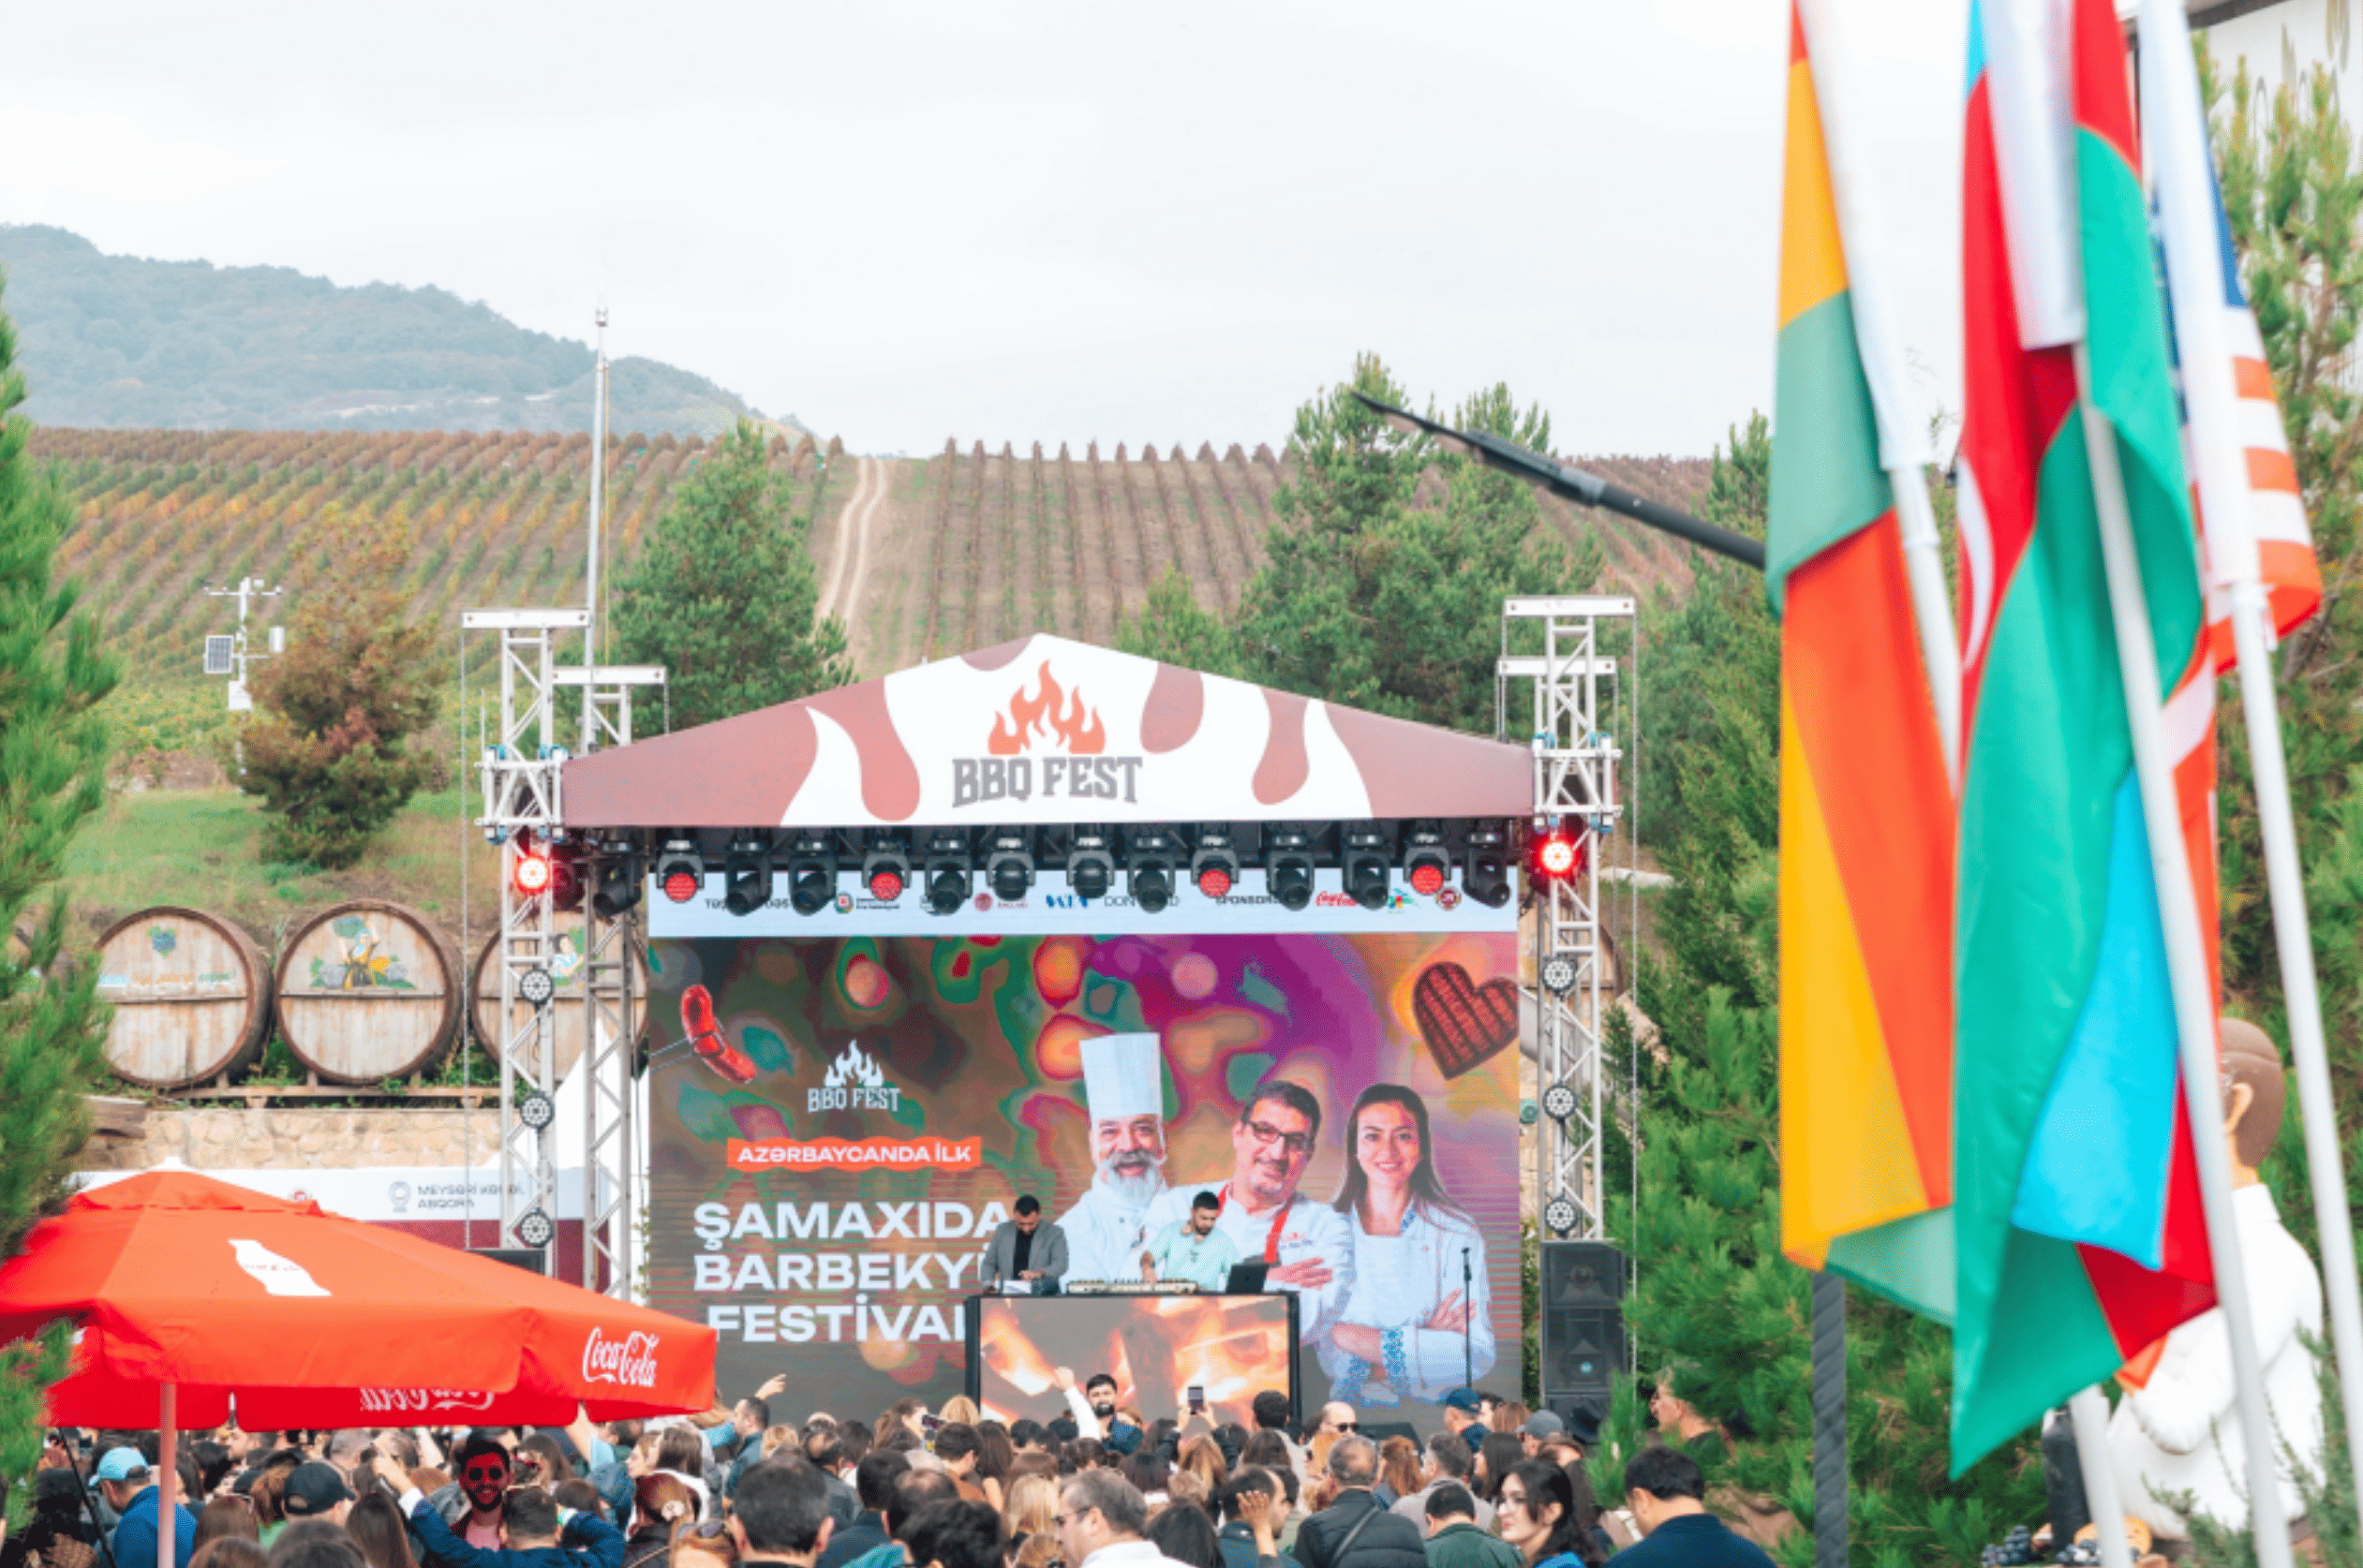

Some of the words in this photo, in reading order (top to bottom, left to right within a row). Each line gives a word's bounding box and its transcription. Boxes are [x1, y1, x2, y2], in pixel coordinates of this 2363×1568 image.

[952, 757, 1032, 807] BBQ
[1042, 755, 1143, 805] FEST
[852, 1087, 901, 1112] FEST
[737, 1146, 930, 1163] AZƏRBAYCANDA
[934, 1141, 971, 1163] İLK
[694, 1202, 1009, 1250] ŞAMAXIDA
[694, 1242, 988, 1292] BARBEKY
[582, 1326, 660, 1387] Coca-Cola
